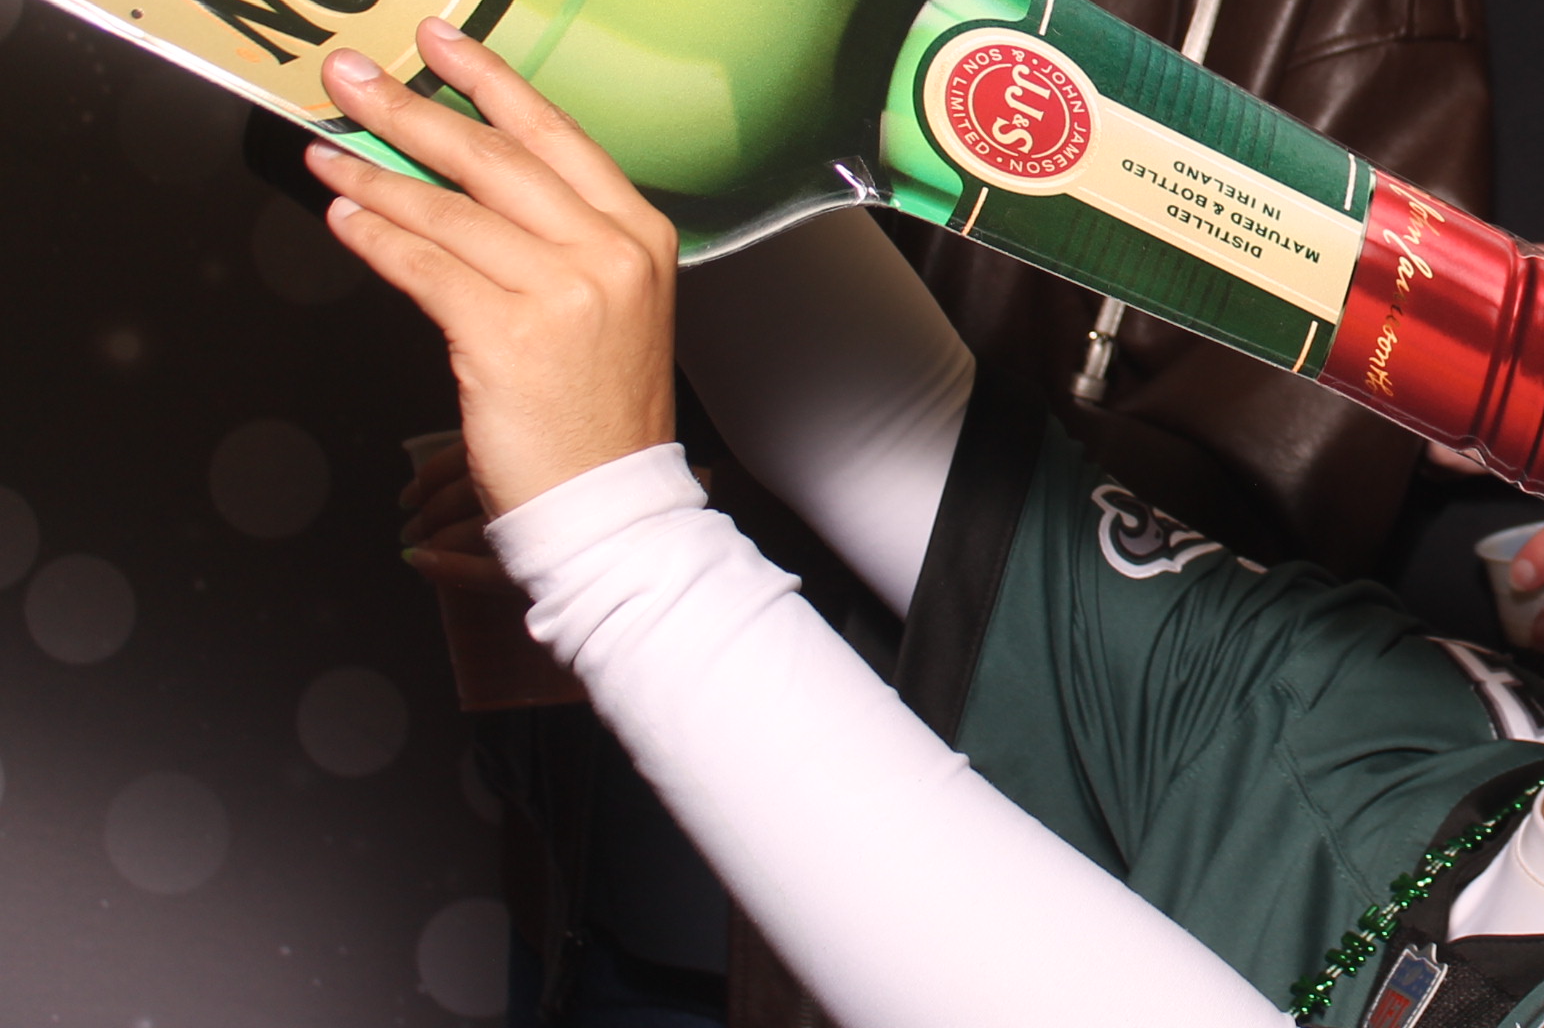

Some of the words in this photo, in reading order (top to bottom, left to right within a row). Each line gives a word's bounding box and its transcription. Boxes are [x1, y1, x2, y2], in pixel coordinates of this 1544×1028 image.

[962, 48, 1003, 75] SON
[1011, 48, 1025, 63] &
[1041, 64, 1086, 114] JOHN
[950, 76, 990, 155] LIMITED
[1009, 122, 1088, 174] JAMESON
[1121, 158, 1208, 208] BOTTLED
[1173, 160, 1257, 209] IRELAND
[1212, 201, 1225, 215] &
[1166, 204, 1263, 259] DISTILLED
[1230, 211, 1321, 264] MATURED
[1262, 207, 1281, 221] IN
